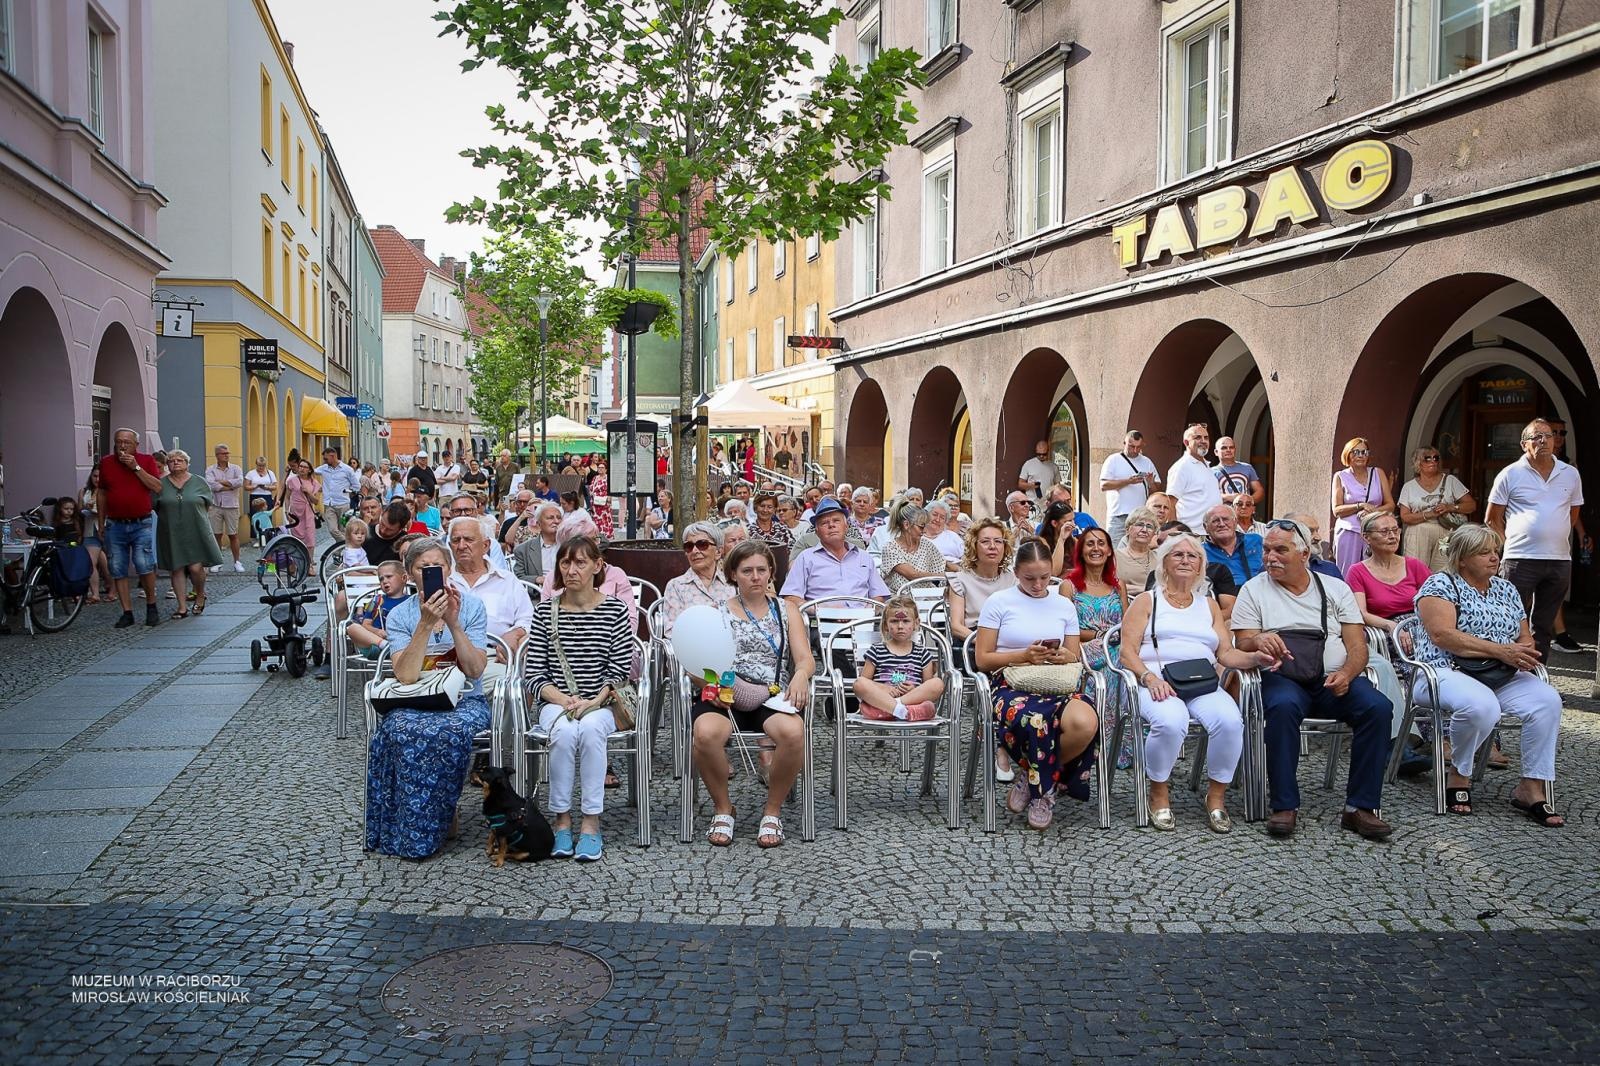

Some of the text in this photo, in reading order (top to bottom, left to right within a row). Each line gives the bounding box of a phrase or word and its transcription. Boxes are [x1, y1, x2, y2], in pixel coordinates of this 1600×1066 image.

[1112, 139, 1392, 269] TABAC
[174, 314, 182, 332] i
[1478, 378, 1526, 389] TABAC
